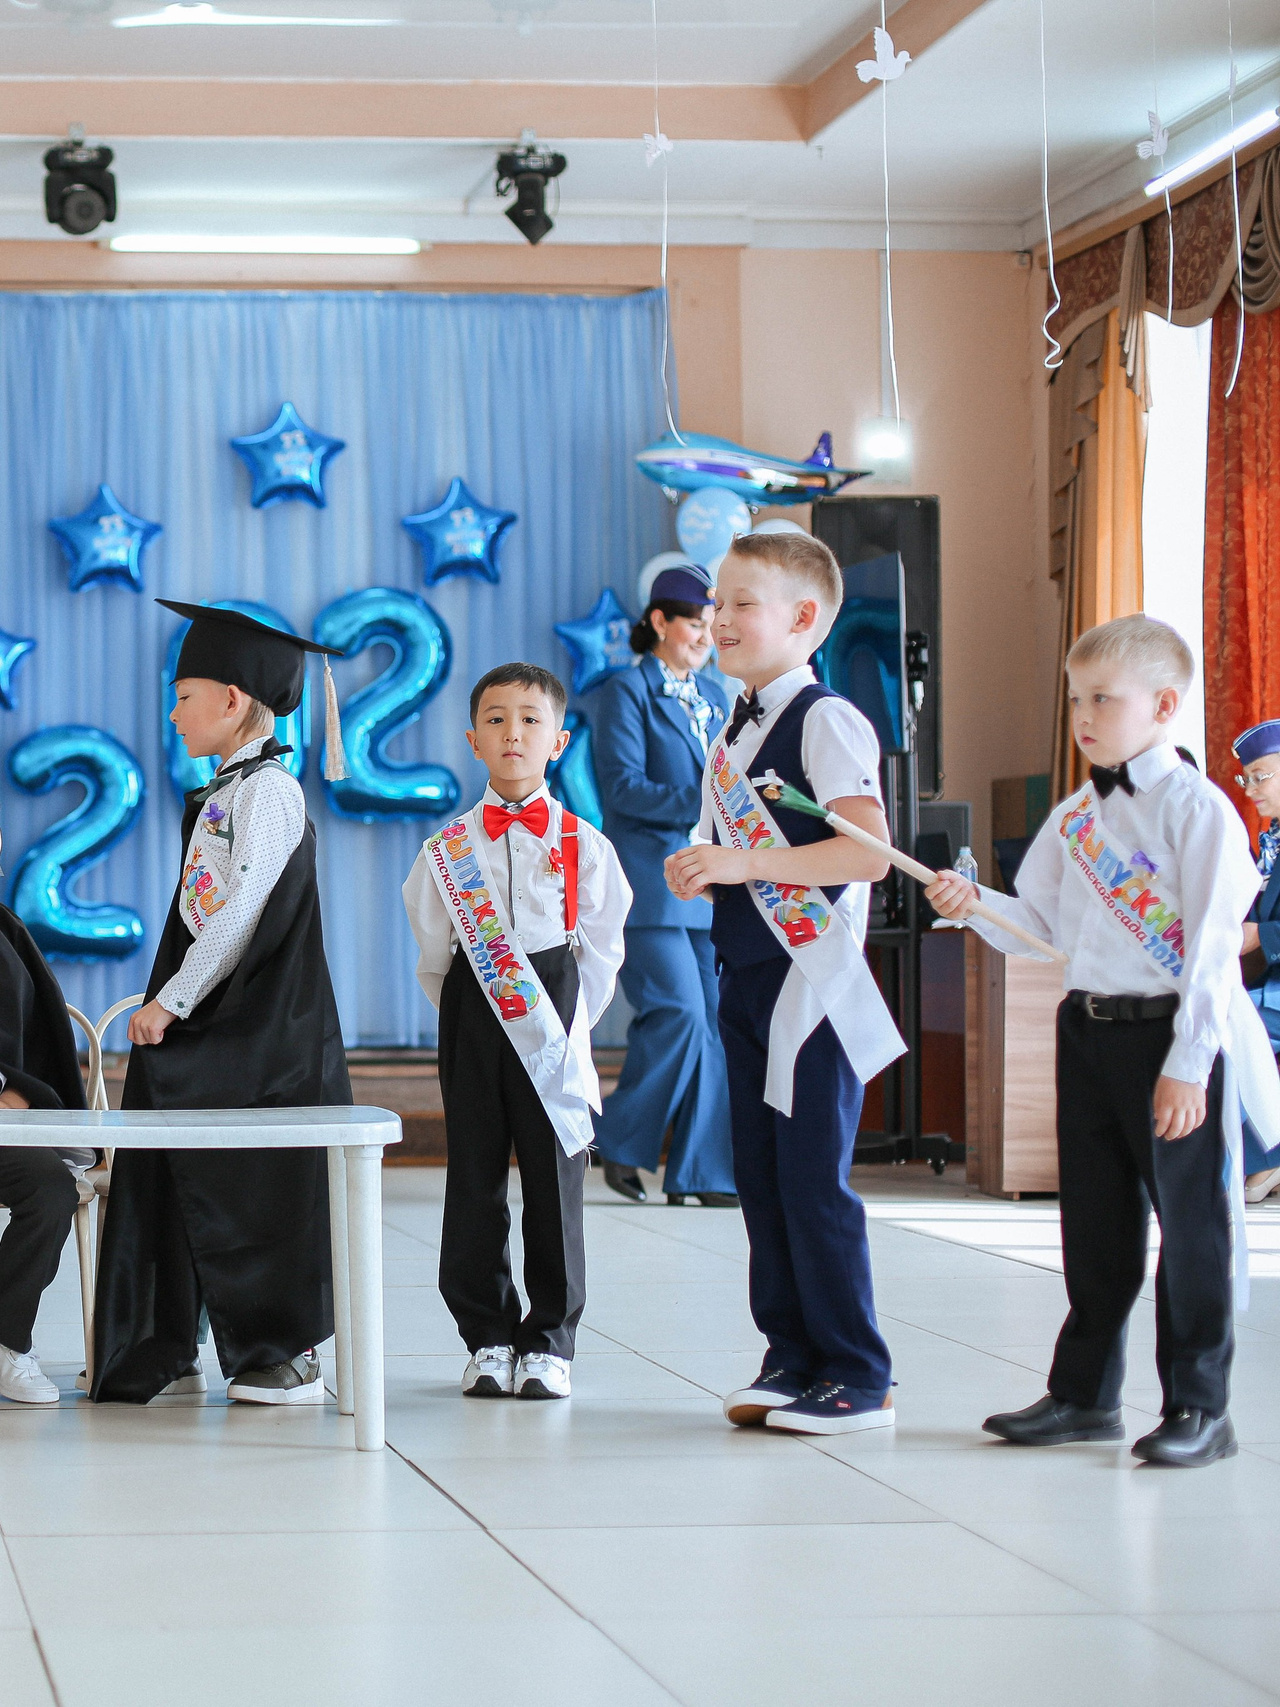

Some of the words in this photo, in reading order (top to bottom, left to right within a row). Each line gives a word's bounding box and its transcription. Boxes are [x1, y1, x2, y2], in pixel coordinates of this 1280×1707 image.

[430, 839, 461, 907] детского
[456, 907, 478, 946] сада
[470, 941, 497, 984] 2024
[442, 822, 521, 979] ВЫПУСКНИК
[1071, 846, 1116, 909] детского
[1113, 908, 1148, 944] сада
[1143, 934, 1184, 978] 2024
[1077, 816, 1185, 959] ВЫПУСКНИ
